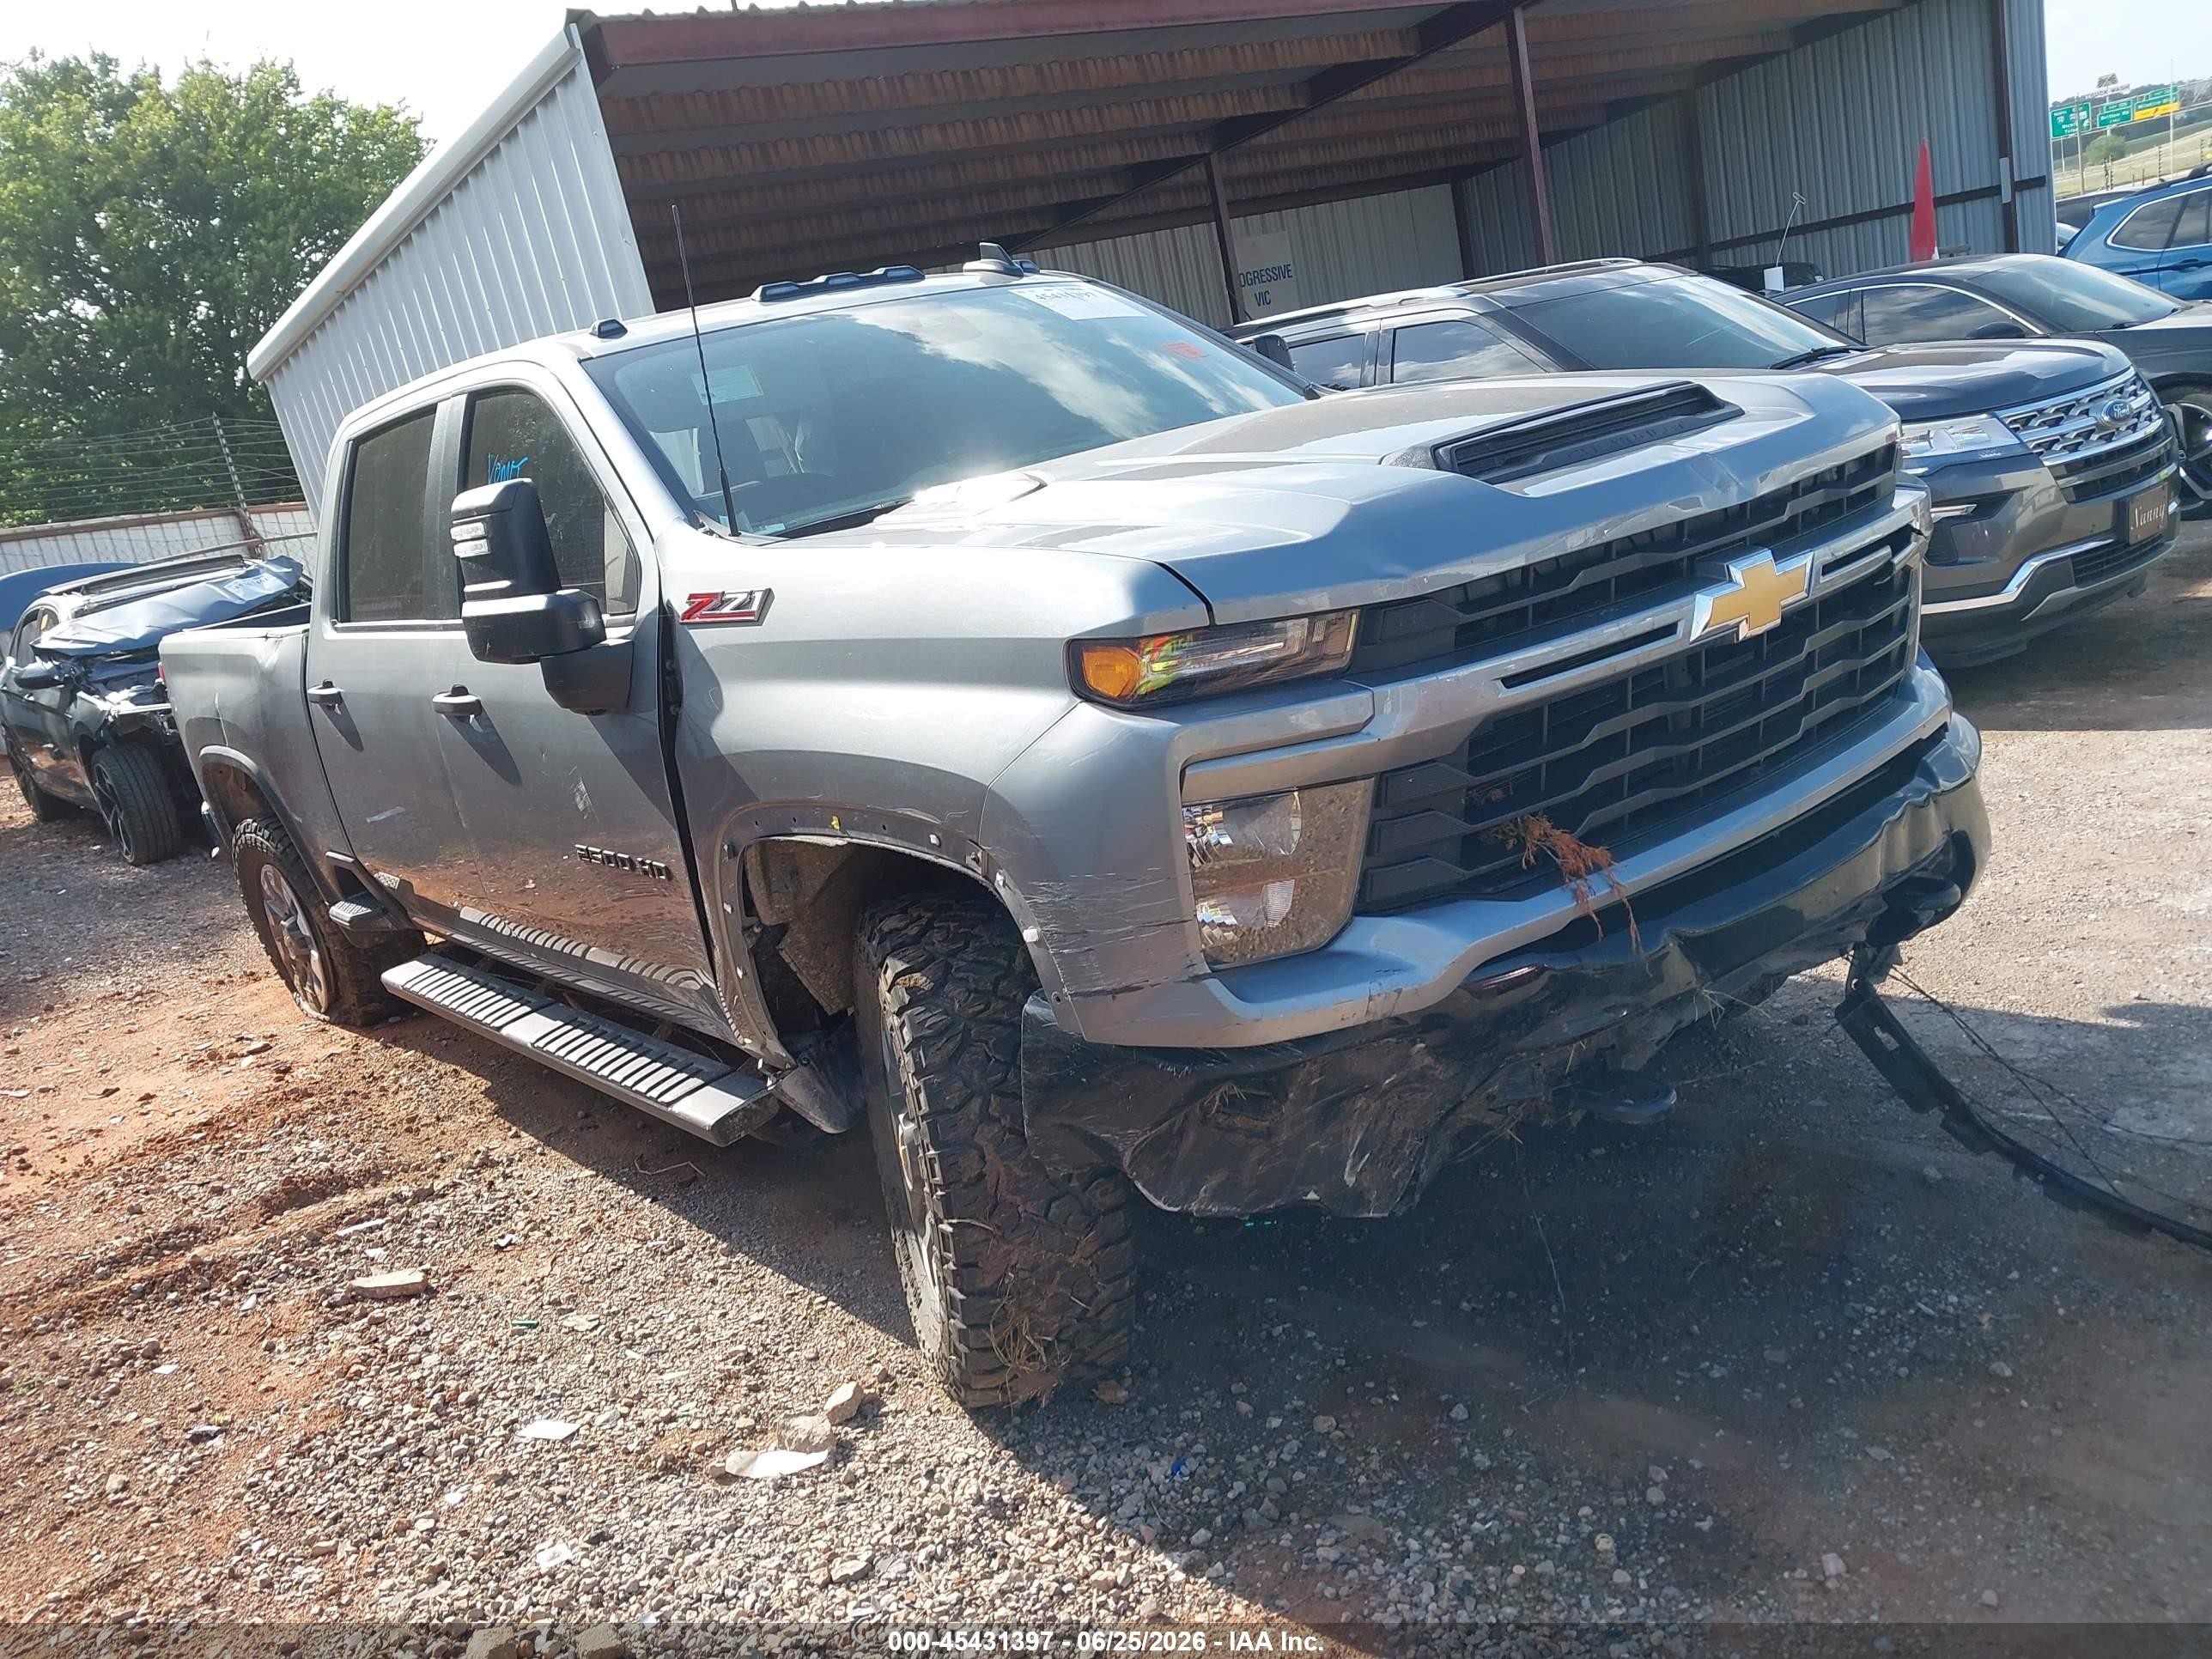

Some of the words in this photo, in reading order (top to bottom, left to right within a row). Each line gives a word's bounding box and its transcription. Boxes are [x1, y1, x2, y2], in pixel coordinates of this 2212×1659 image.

[1255, 290, 1272, 307] VIC
[2113, 403, 2130, 419] Ford
[2130, 501, 2166, 530] Nanny
[678, 588, 768, 624] Z71
